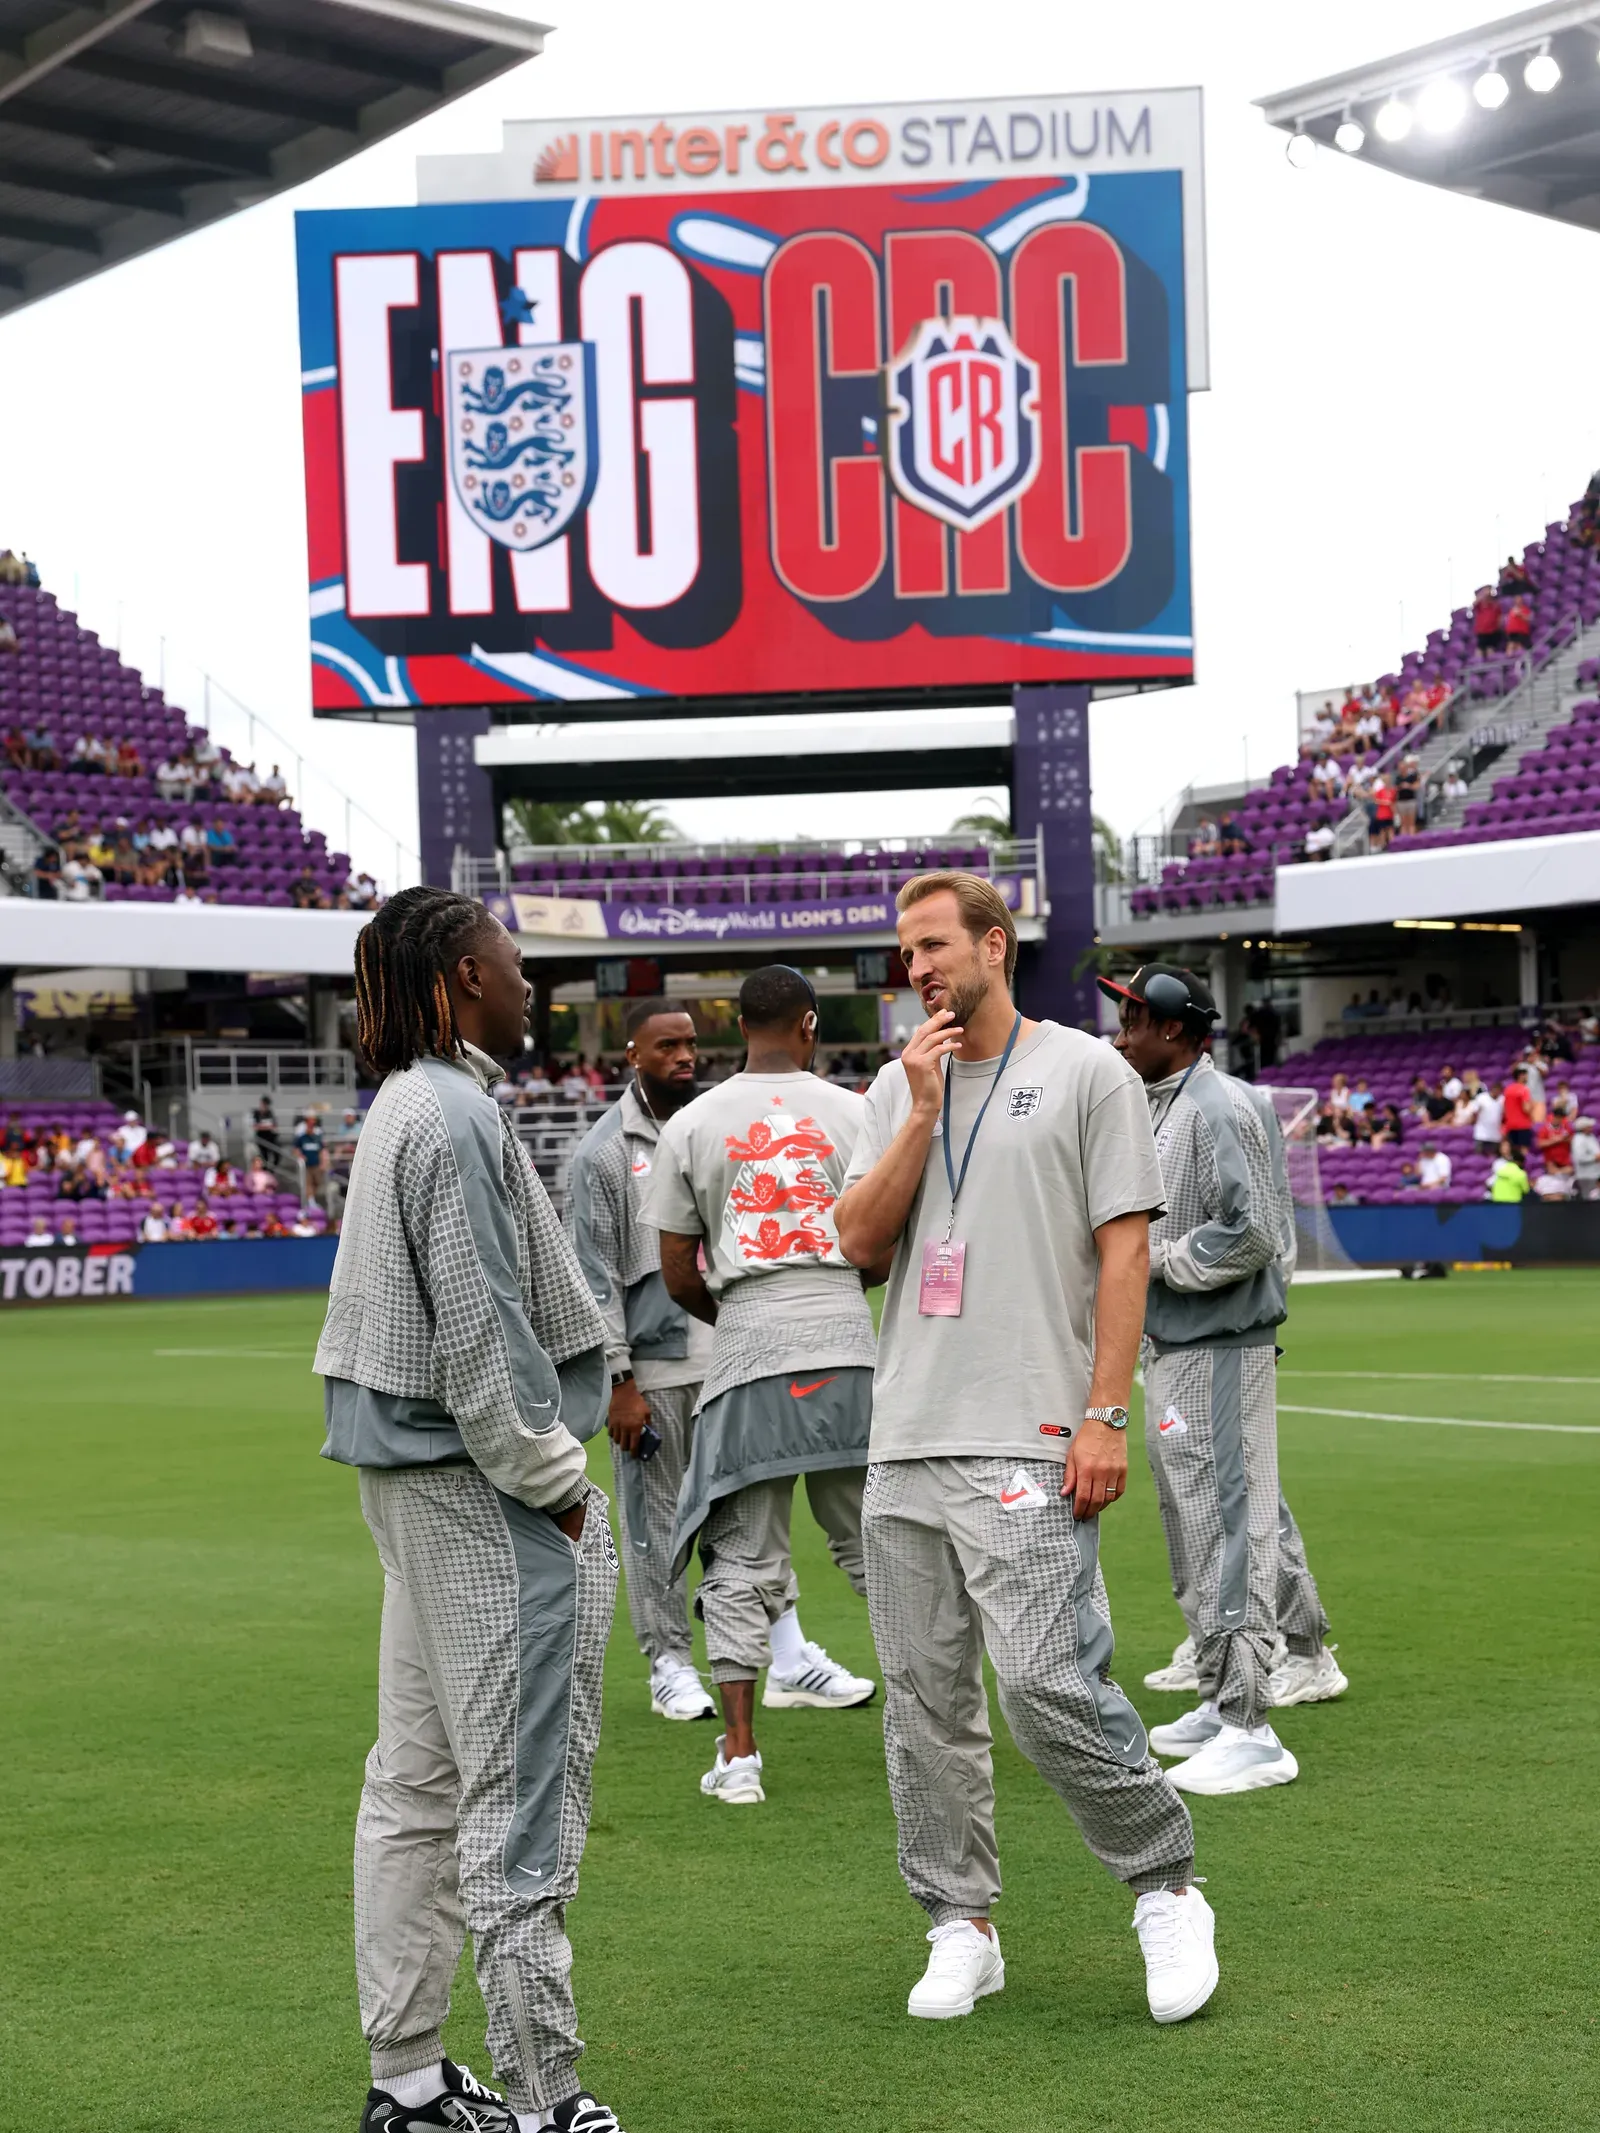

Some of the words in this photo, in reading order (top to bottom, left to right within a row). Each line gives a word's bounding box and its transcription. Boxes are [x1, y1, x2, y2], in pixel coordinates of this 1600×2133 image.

[900, 105, 1152, 167] STADIUM
[335, 240, 701, 618] ENG
[928, 360, 1005, 489] CR
[656, 906, 730, 940] Disney
[728, 910, 776, 930] World
[780, 907, 844, 929] LION'S
[846, 904, 888, 925] DEN
[0, 1254, 136, 1299] TOBER
[1042, 1426, 1059, 1434] PALACE
